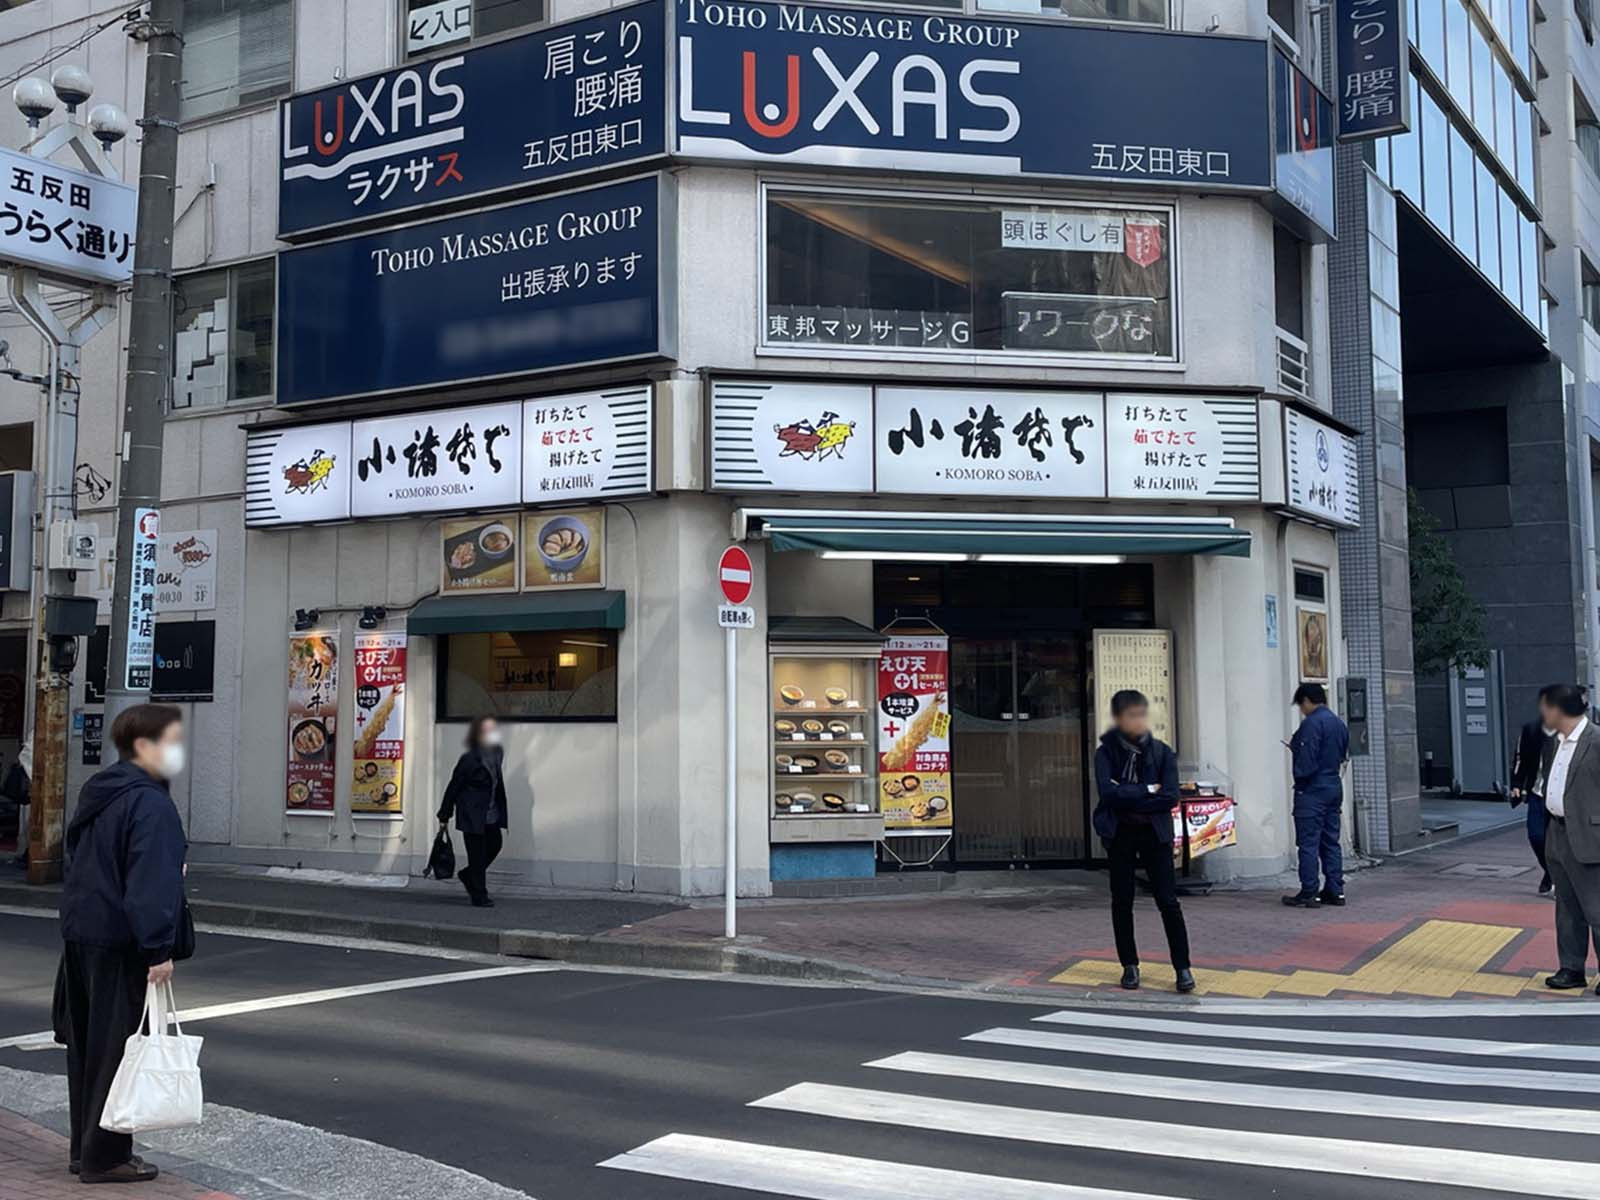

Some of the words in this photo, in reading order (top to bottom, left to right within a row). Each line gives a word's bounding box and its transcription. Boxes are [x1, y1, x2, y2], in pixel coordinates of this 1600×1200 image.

[431, 5, 470, 38] 入口
[544, 20, 642, 80] 肩こり
[574, 63, 643, 118] 腰痛
[680, 36, 1020, 143] LUXAS
[284, 56, 464, 159] LUXAS
[523, 119, 642, 170] 五反田東口
[1091, 143, 1229, 176] 五反田東口
[10, 166, 91, 211] 五反田
[347, 152, 463, 206] ラクサス
[0, 201, 132, 263] うらく通り
[1004, 218, 1121, 245] 頭ほぐし有
[501, 251, 642, 302] 出張承ります
[769, 314, 969, 344] 東邦マッサージG
[535, 404, 588, 424] 打ちたて
[1125, 405, 1188, 422] 打ちたて
[541, 426, 595, 447] 茹でたて
[1133, 429, 1197, 445] 茹でたて
[550, 448, 602, 468] 揚げたて
[1145, 451, 1208, 468] 揚げたて
[538, 474, 595, 493] 東五反田店
[945, 468, 1005, 481] KOMORO
[1008, 469, 1044, 481] SOBA
[1133, 475, 1199, 491] 東五反田店
[396, 486, 439, 500] KOMORO
[441, 484, 469, 497] SOBA
[356, 650, 390, 666] えび天
[880, 655, 927, 672] えび天
